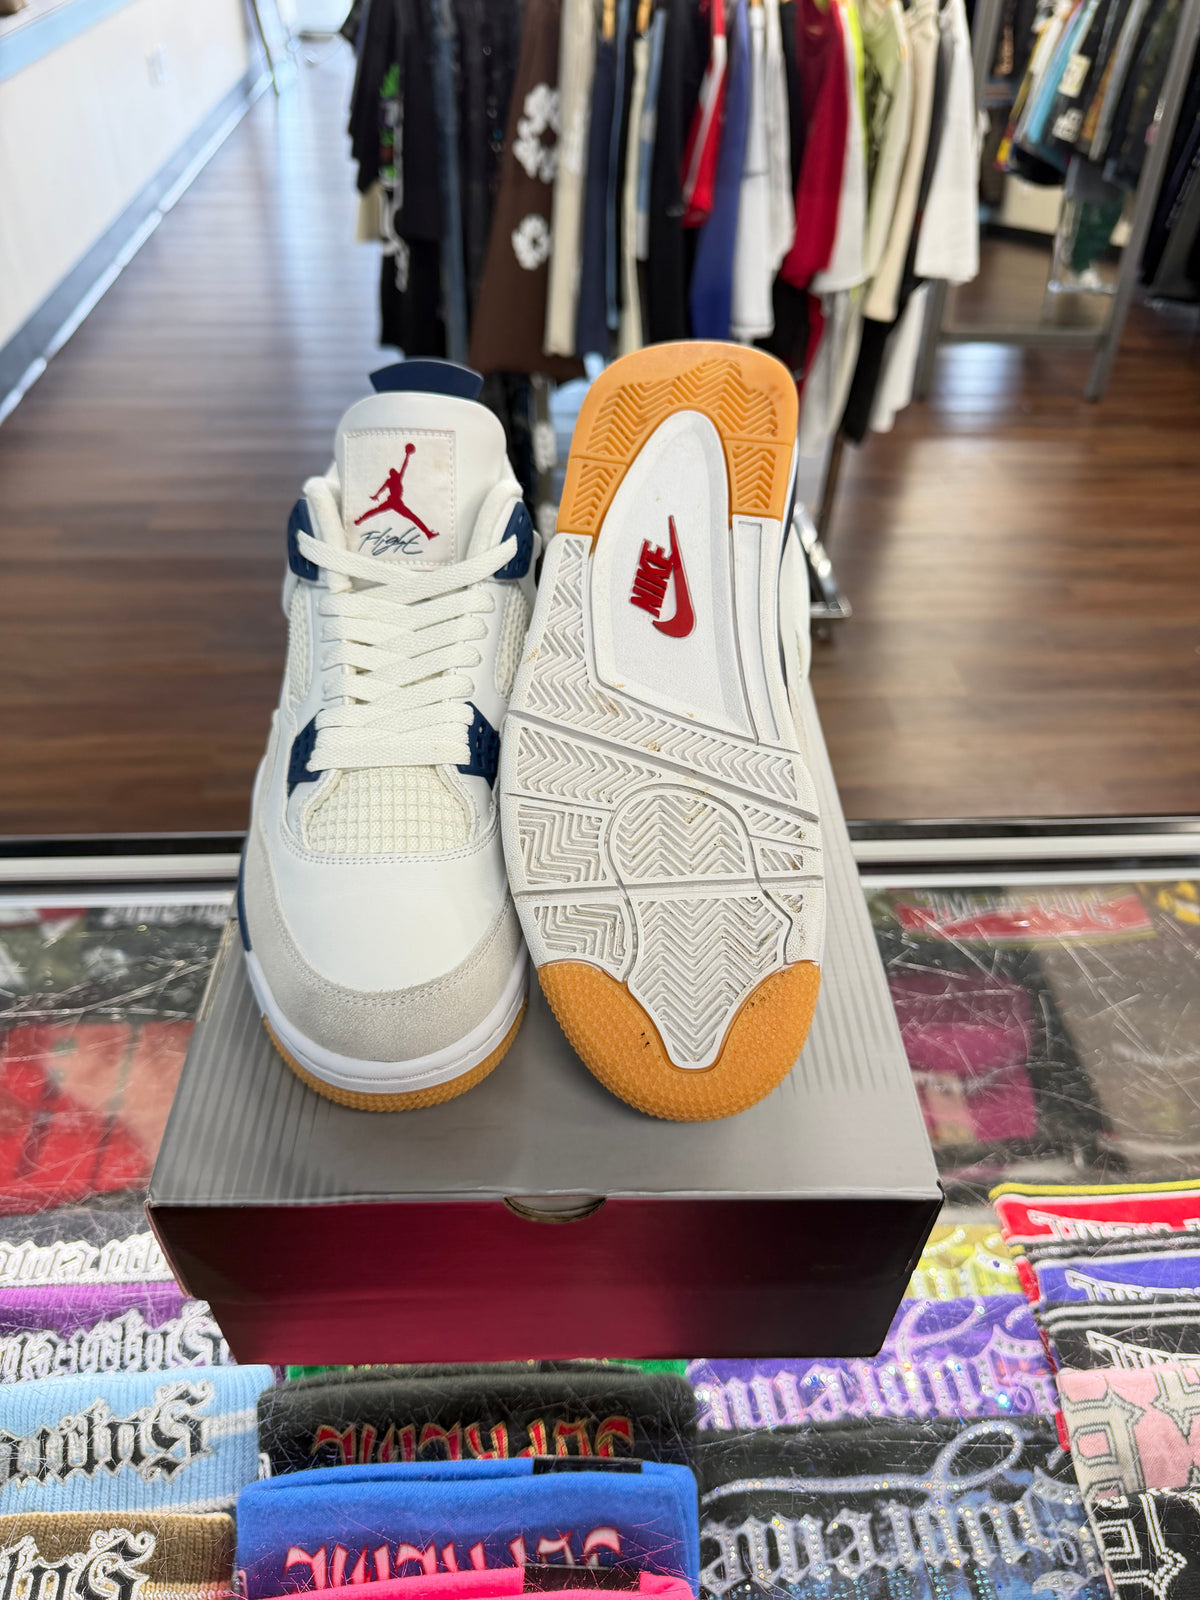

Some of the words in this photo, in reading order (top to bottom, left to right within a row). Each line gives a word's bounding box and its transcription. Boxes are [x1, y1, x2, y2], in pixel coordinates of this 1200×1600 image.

[358, 526, 424, 556] Flight
[628, 538, 674, 619] NIKE
[0, 1379, 215, 1489] Supr
